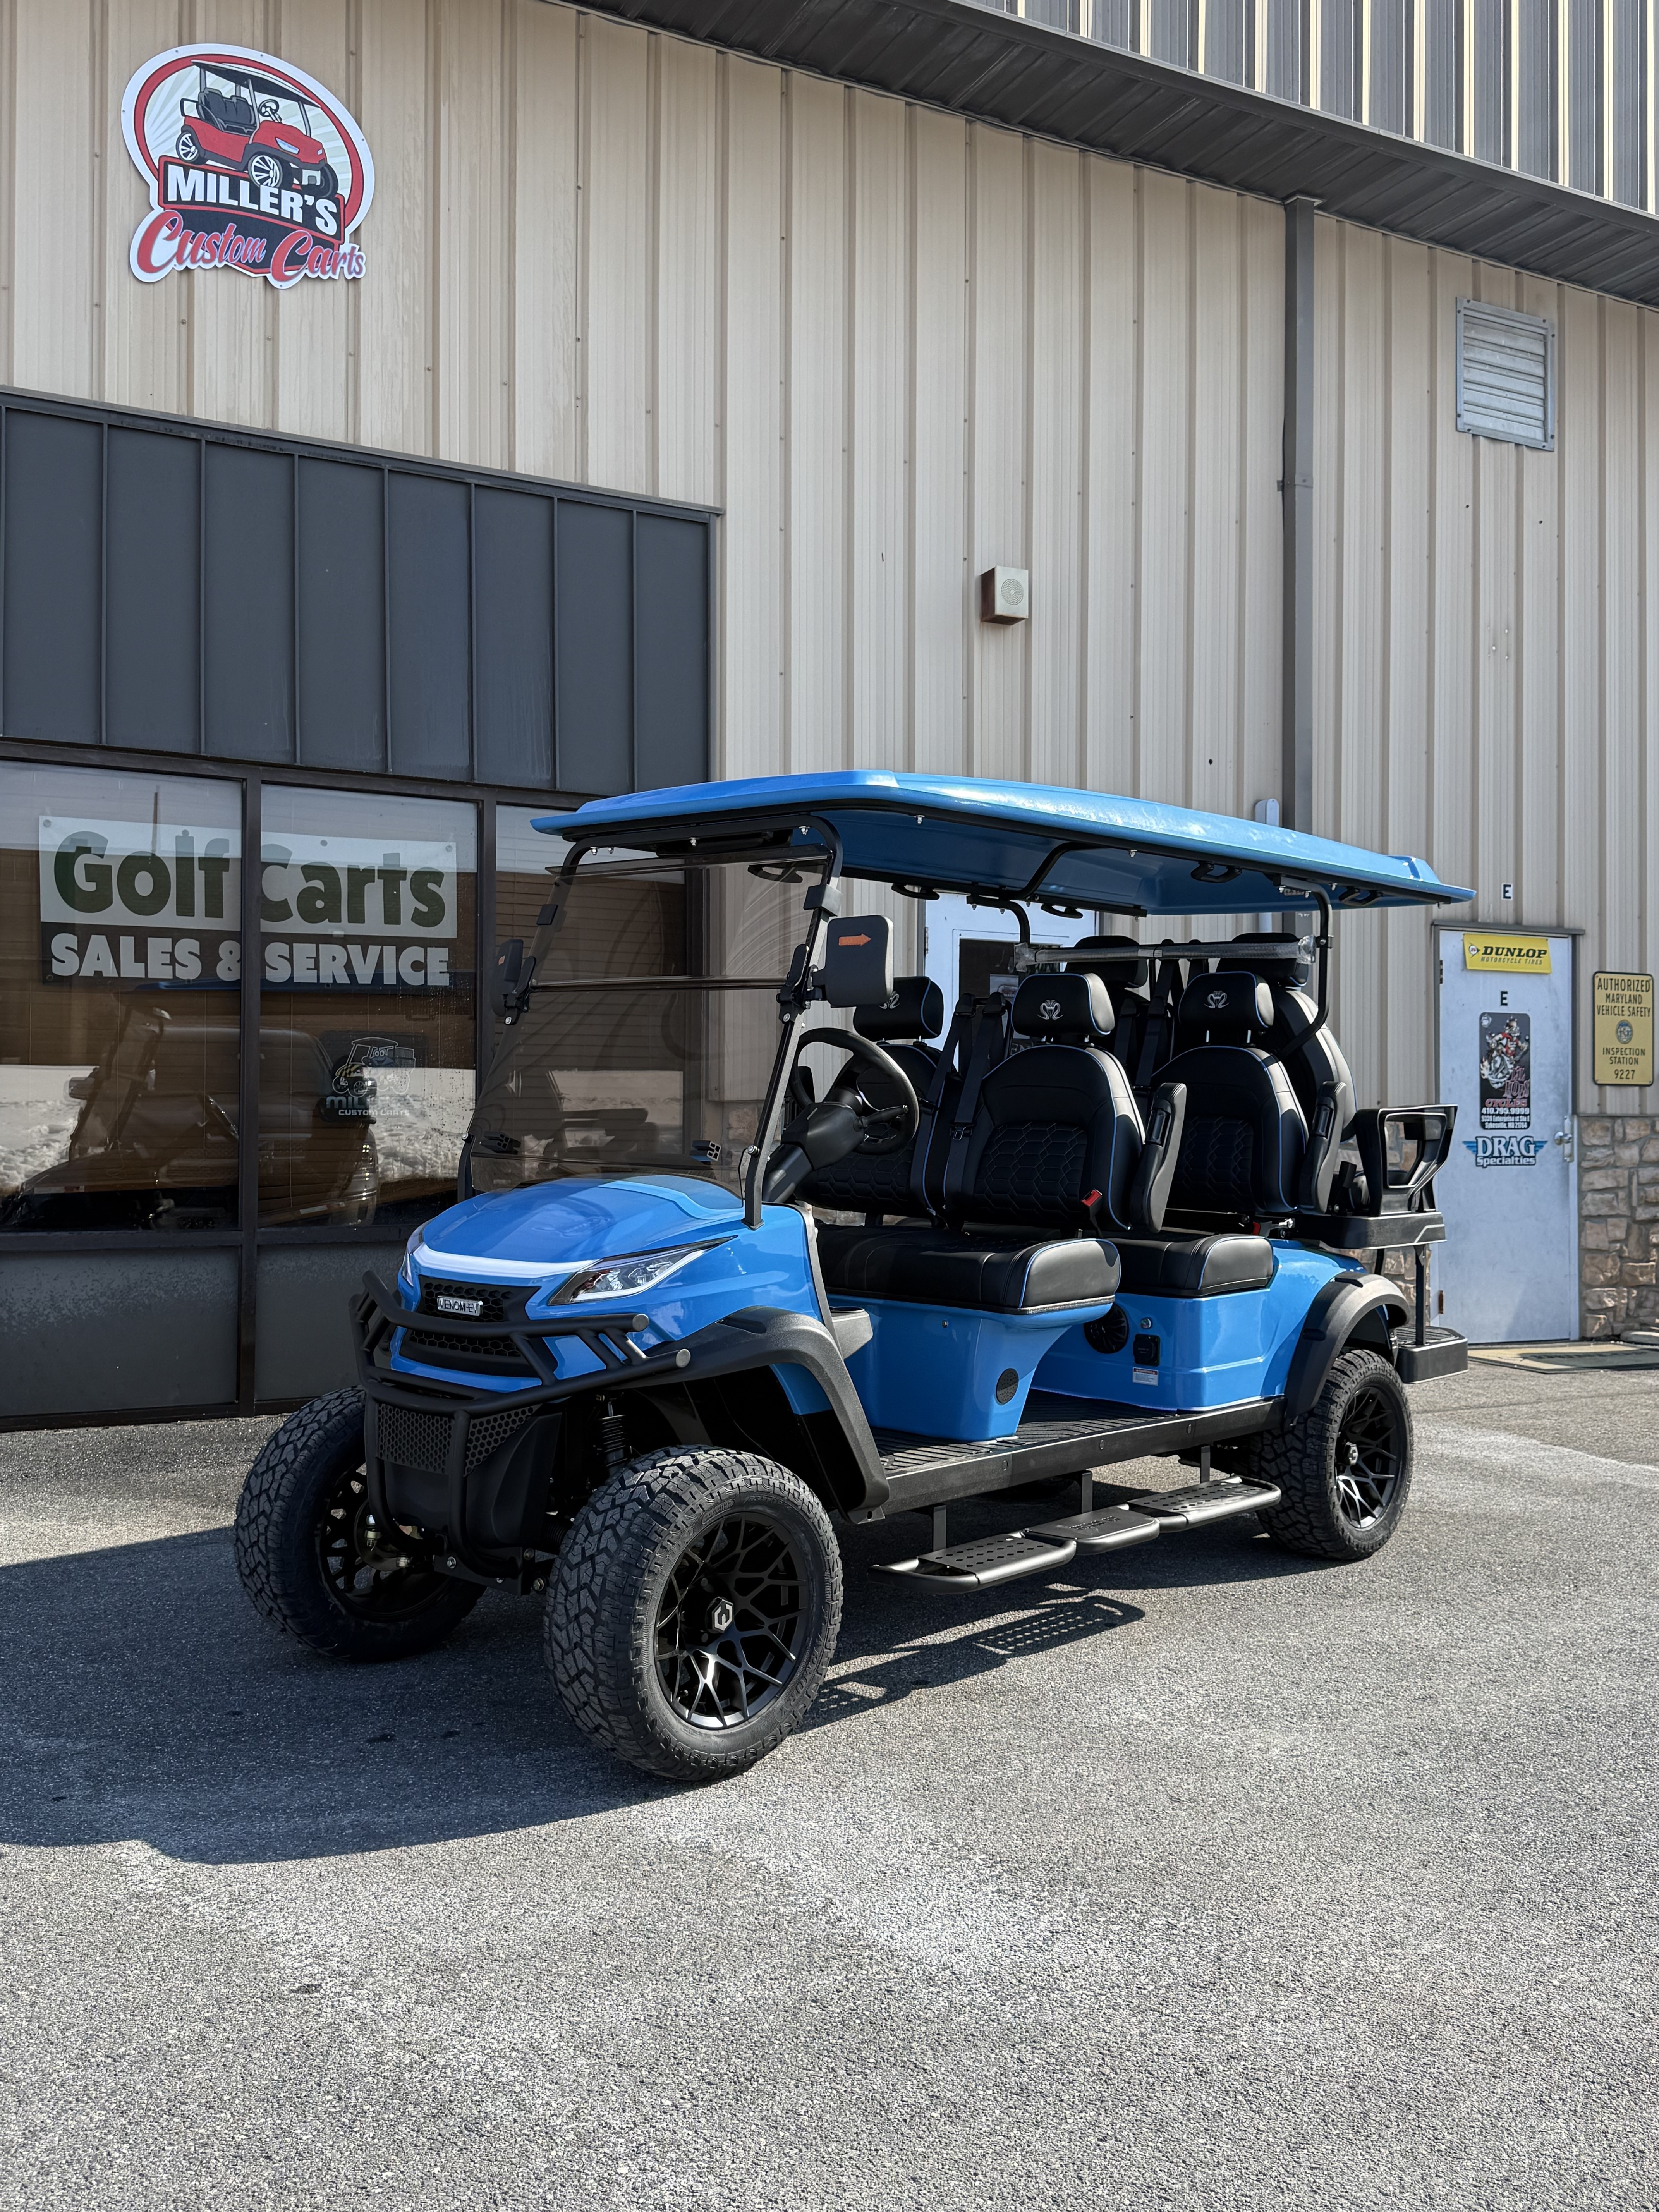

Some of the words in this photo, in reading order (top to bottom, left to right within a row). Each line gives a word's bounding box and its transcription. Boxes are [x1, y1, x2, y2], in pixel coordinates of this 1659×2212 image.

[168, 164, 337, 235] MILLER'S
[137, 210, 266, 273] Custom
[271, 230, 365, 282] Carts
[54, 831, 230, 918] Golf
[261, 844, 445, 927] Carts
[1503, 884, 1511, 899] E
[1482, 946, 1547, 958] DUNLOP
[51, 933, 201, 979] SALES
[216, 940, 240, 981] &
[265, 942, 450, 986] SERVICE
[1597, 978, 1650, 992] AUTHORIZED
[1500, 991, 1508, 1006] E
[1606, 993, 1642, 1004] MARYLAND
[1597, 1005, 1625, 1016] VEHICLE
[1628, 1006, 1650, 1017] SAFETY
[1603, 1047, 1645, 1056] INSPECTION
[1609, 1056, 1638, 1065] STATION
[1614, 1069, 1635, 1080] 9227
[1485, 1098, 1527, 1108] CYCLES
[1476, 1137, 1535, 1156] DRAG
[1476, 1156, 1535, 1167] Specialties
